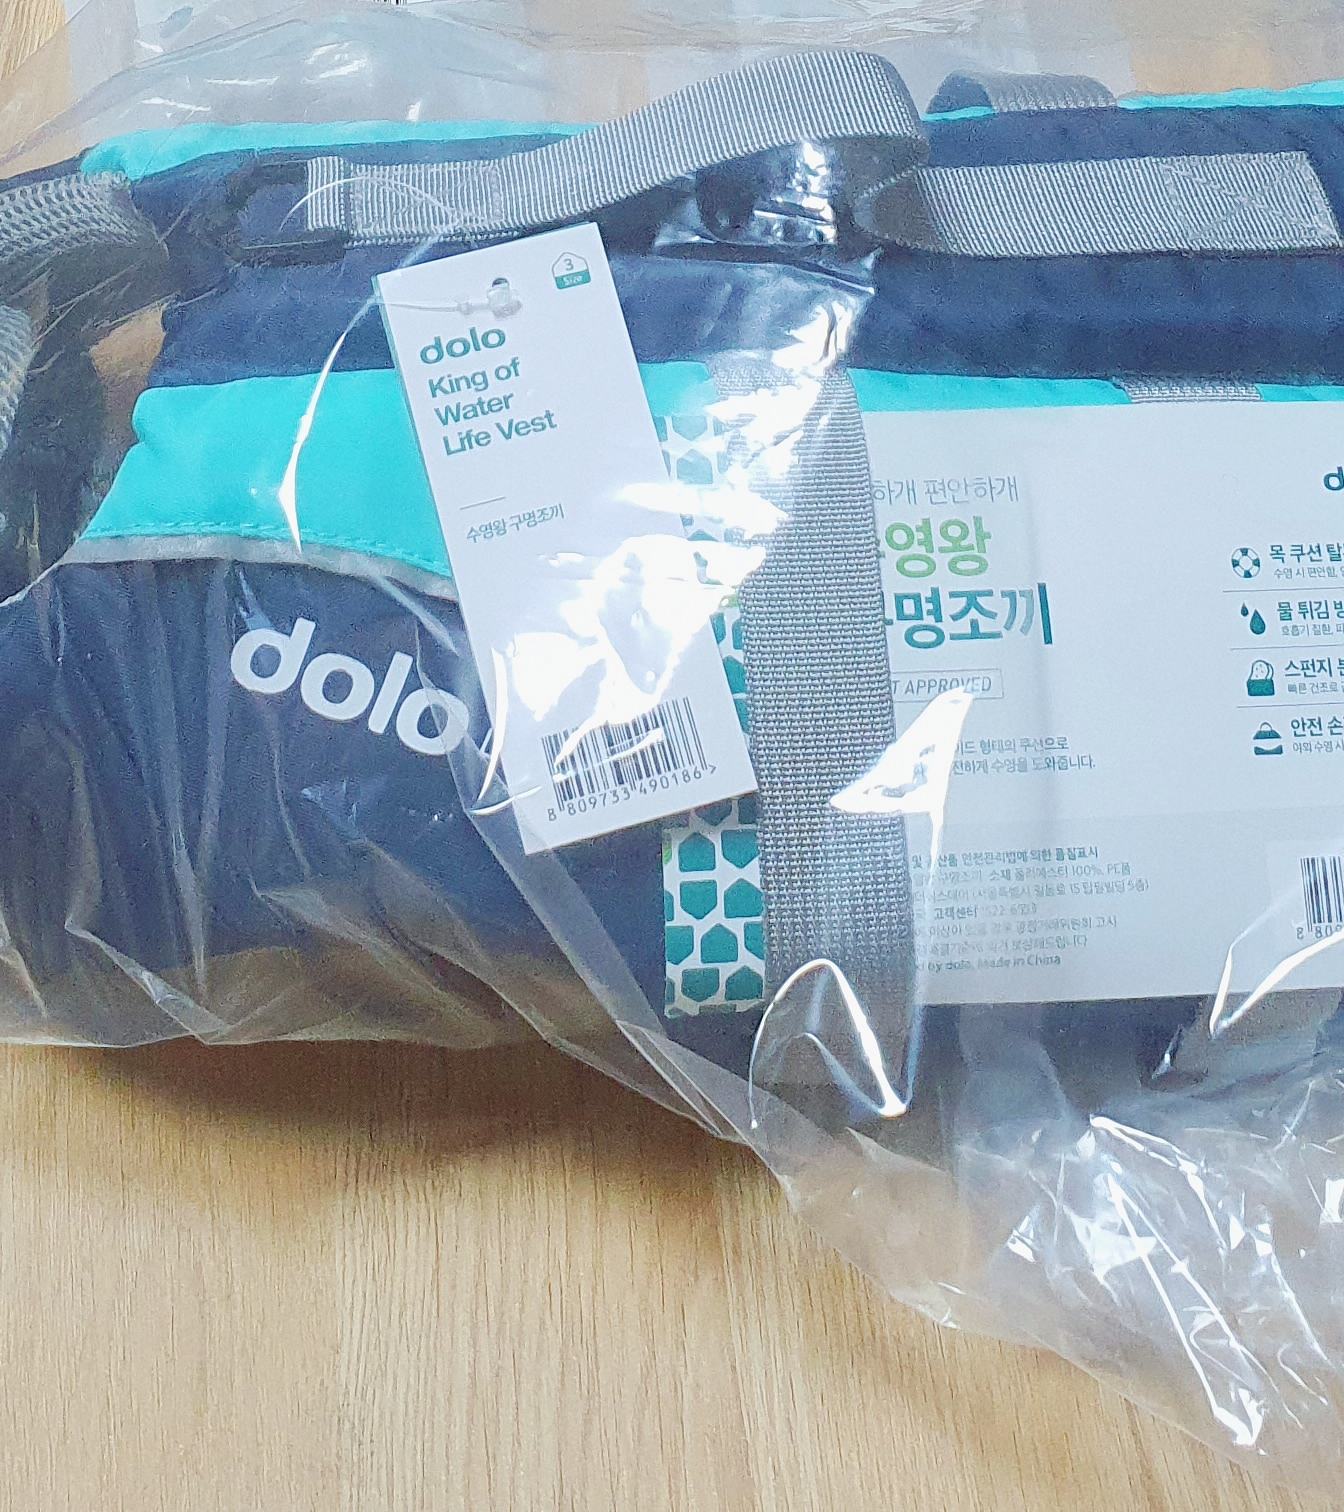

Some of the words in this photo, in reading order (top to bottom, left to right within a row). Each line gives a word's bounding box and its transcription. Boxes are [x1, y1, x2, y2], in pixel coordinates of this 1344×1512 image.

[564, 258, 574, 271] 3
[419, 326, 506, 365] dolo
[427, 369, 489, 398] King
[494, 357, 521, 381] of
[434, 392, 514, 426] Water
[442, 427, 492, 456] Life
[496, 409, 558, 440] Vest
[924, 475, 1019, 505] 편안하개
[466, 516, 507, 544] 수영왕
[509, 503, 565, 532] 구명조끼
[878, 515, 992, 578] 영왕
[1269, 543, 1286, 563] 목
[1289, 543, 1323, 563] 쿠션
[1273, 567, 1293, 579] 수영
[1296, 567, 1305, 578] 시
[882, 582, 1053, 650] 명조끼
[1277, 602, 1293, 622] 물
[1297, 600, 1330, 621] 튀김
[1284, 657, 1333, 678] 스펀지
[230, 616, 469, 755] dolo
[904, 675, 992, 695] APPROVED
[1291, 717, 1323, 738] 안전
[1336, 739, 1344, 751] 시
[928, 854, 958, 867] 산품
